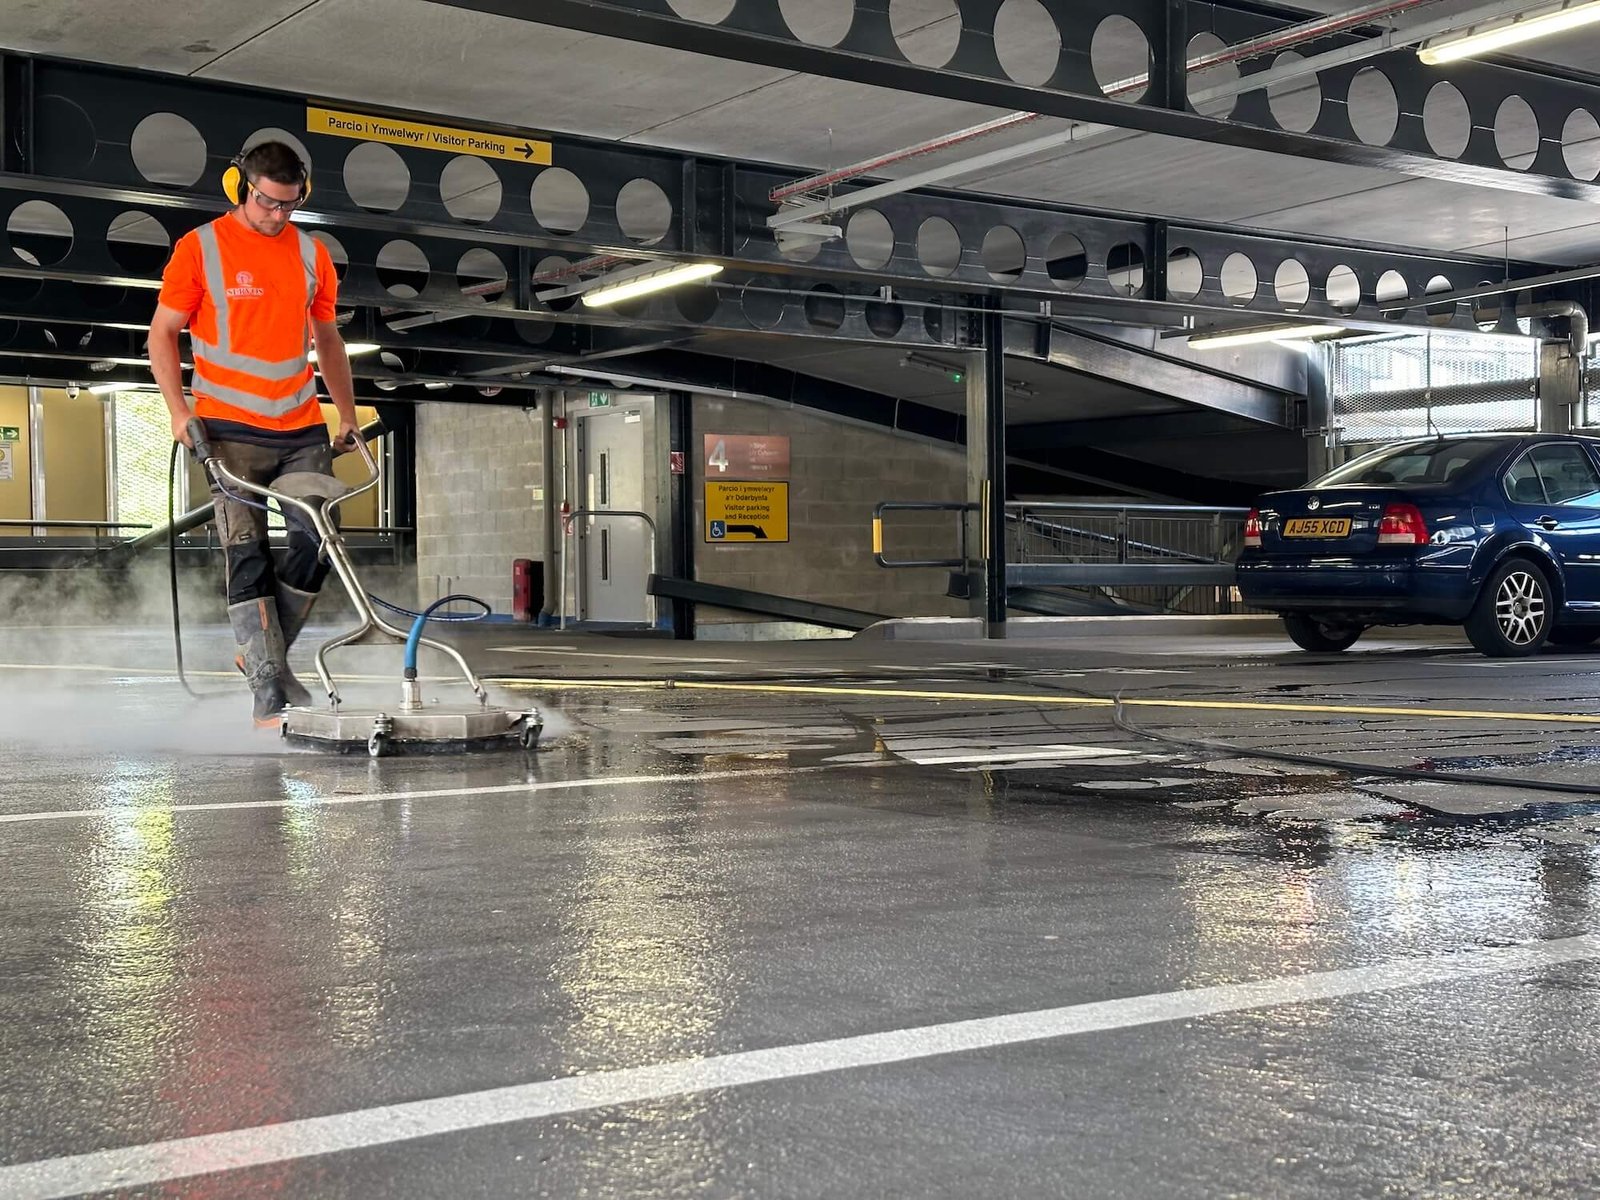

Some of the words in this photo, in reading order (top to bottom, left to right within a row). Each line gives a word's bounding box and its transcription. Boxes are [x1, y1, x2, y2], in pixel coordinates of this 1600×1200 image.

[328, 117, 362, 132] Parcio
[365, 121, 368, 133] i
[372, 124, 424, 142] Ymwelwyr
[432, 133, 466, 147] Visitor
[468, 138, 505, 154] Parking
[708, 440, 729, 472] 4
[746, 504, 770, 512] parking
[1289, 520, 1318, 533] AJ55
[1321, 520, 1345, 533] XCD
